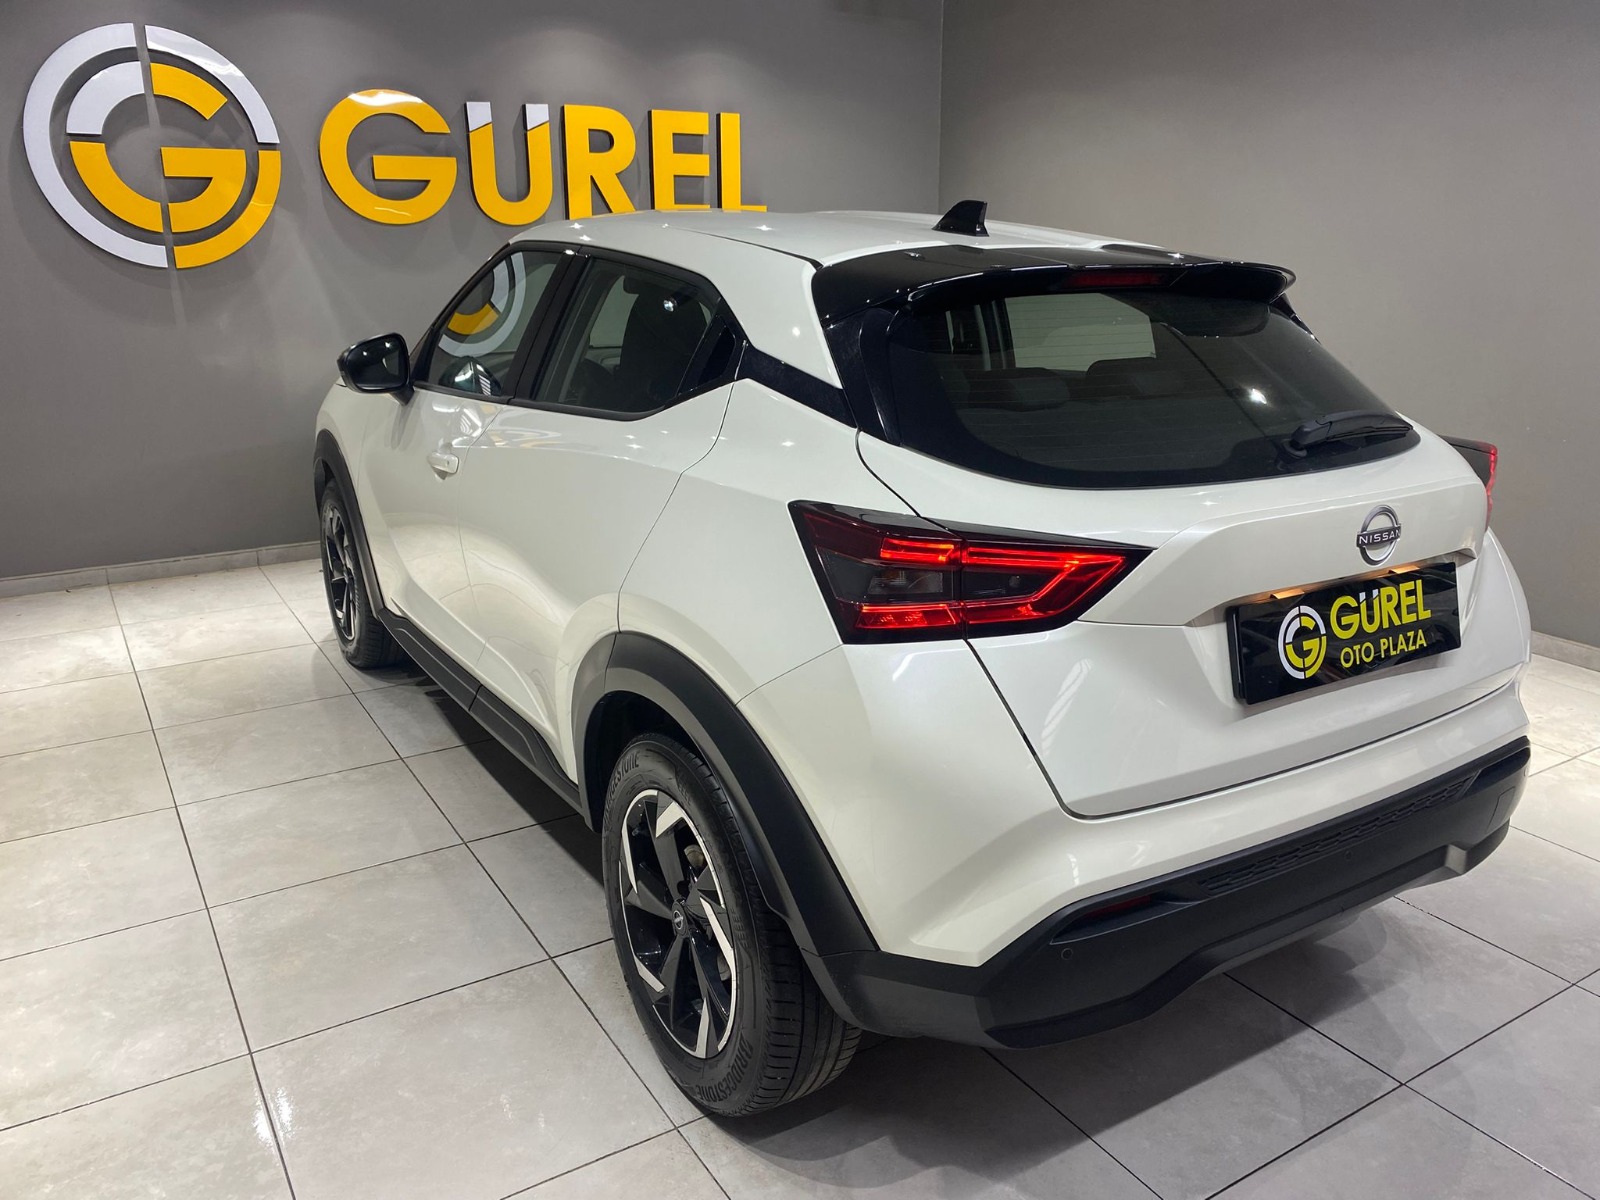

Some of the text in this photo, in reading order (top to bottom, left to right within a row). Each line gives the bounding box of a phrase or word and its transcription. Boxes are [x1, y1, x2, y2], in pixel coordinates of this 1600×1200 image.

[1358, 529, 1401, 545] NISSAN
[1330, 579, 1432, 640] GÜREL
[1339, 629, 1428, 668] OTO PLAZA
